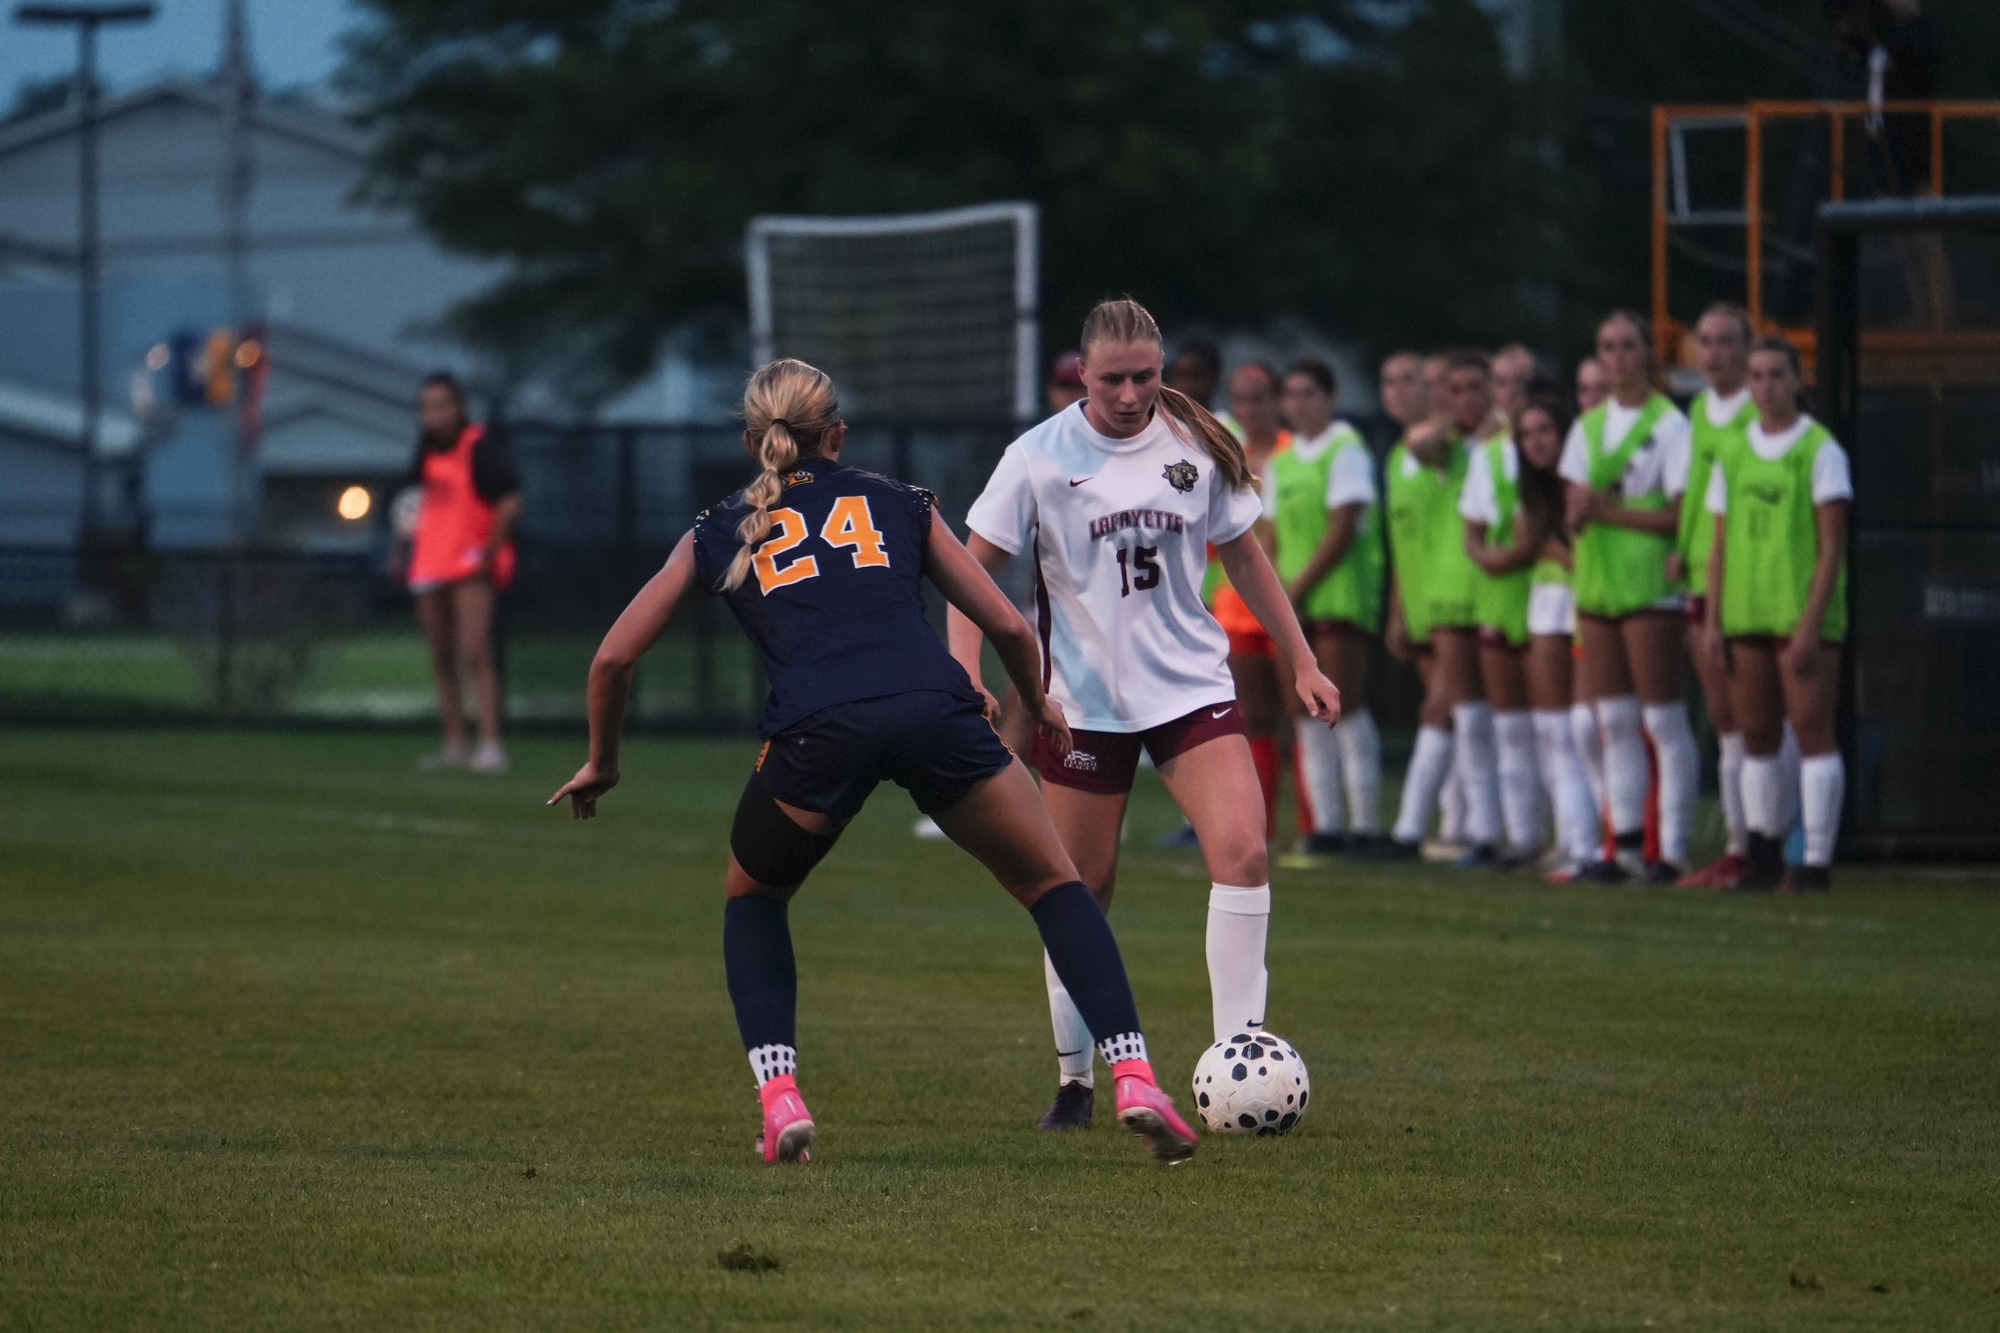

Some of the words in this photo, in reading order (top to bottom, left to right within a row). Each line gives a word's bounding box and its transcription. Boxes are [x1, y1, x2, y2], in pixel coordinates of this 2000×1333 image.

[752, 496, 890, 597] 24
[1088, 508, 1184, 543] LAFAYETTE
[1115, 546, 1160, 599] 15
